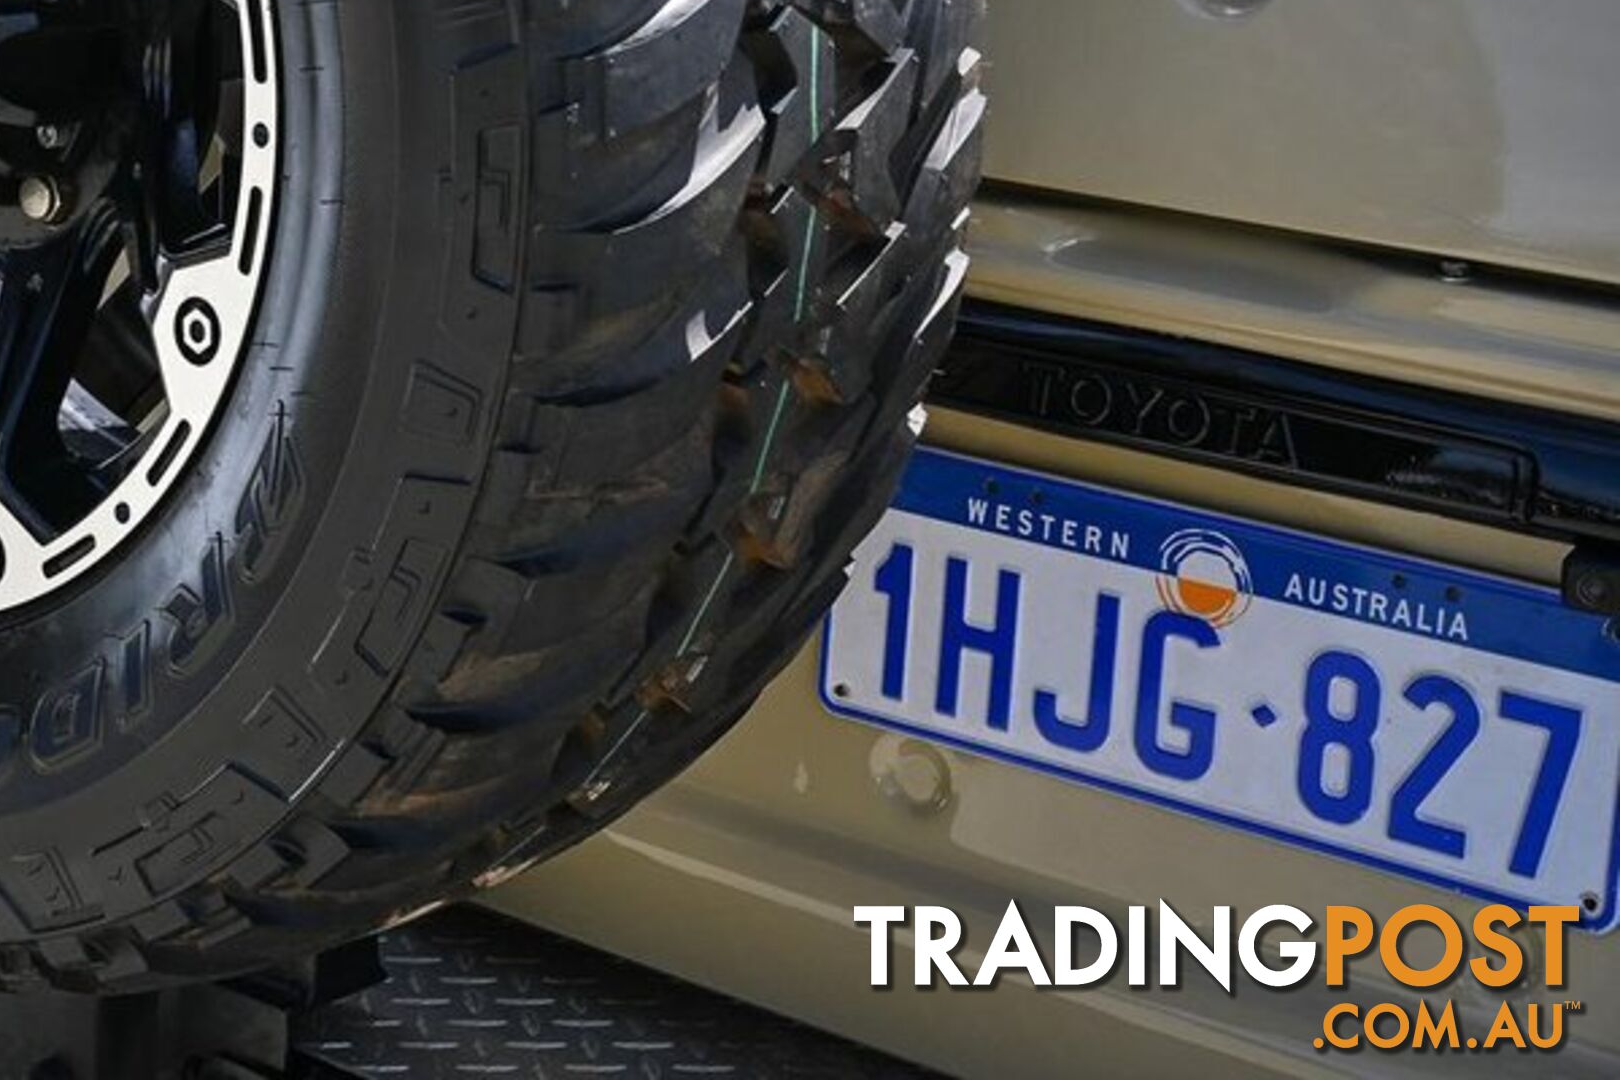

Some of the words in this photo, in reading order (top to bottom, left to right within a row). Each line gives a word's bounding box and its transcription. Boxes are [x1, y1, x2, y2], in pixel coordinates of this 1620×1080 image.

[1021, 362, 1298, 473] TOYOTA
[966, 496, 1132, 560] WESTERN
[1282, 571, 1470, 642] AUSTRALIA
